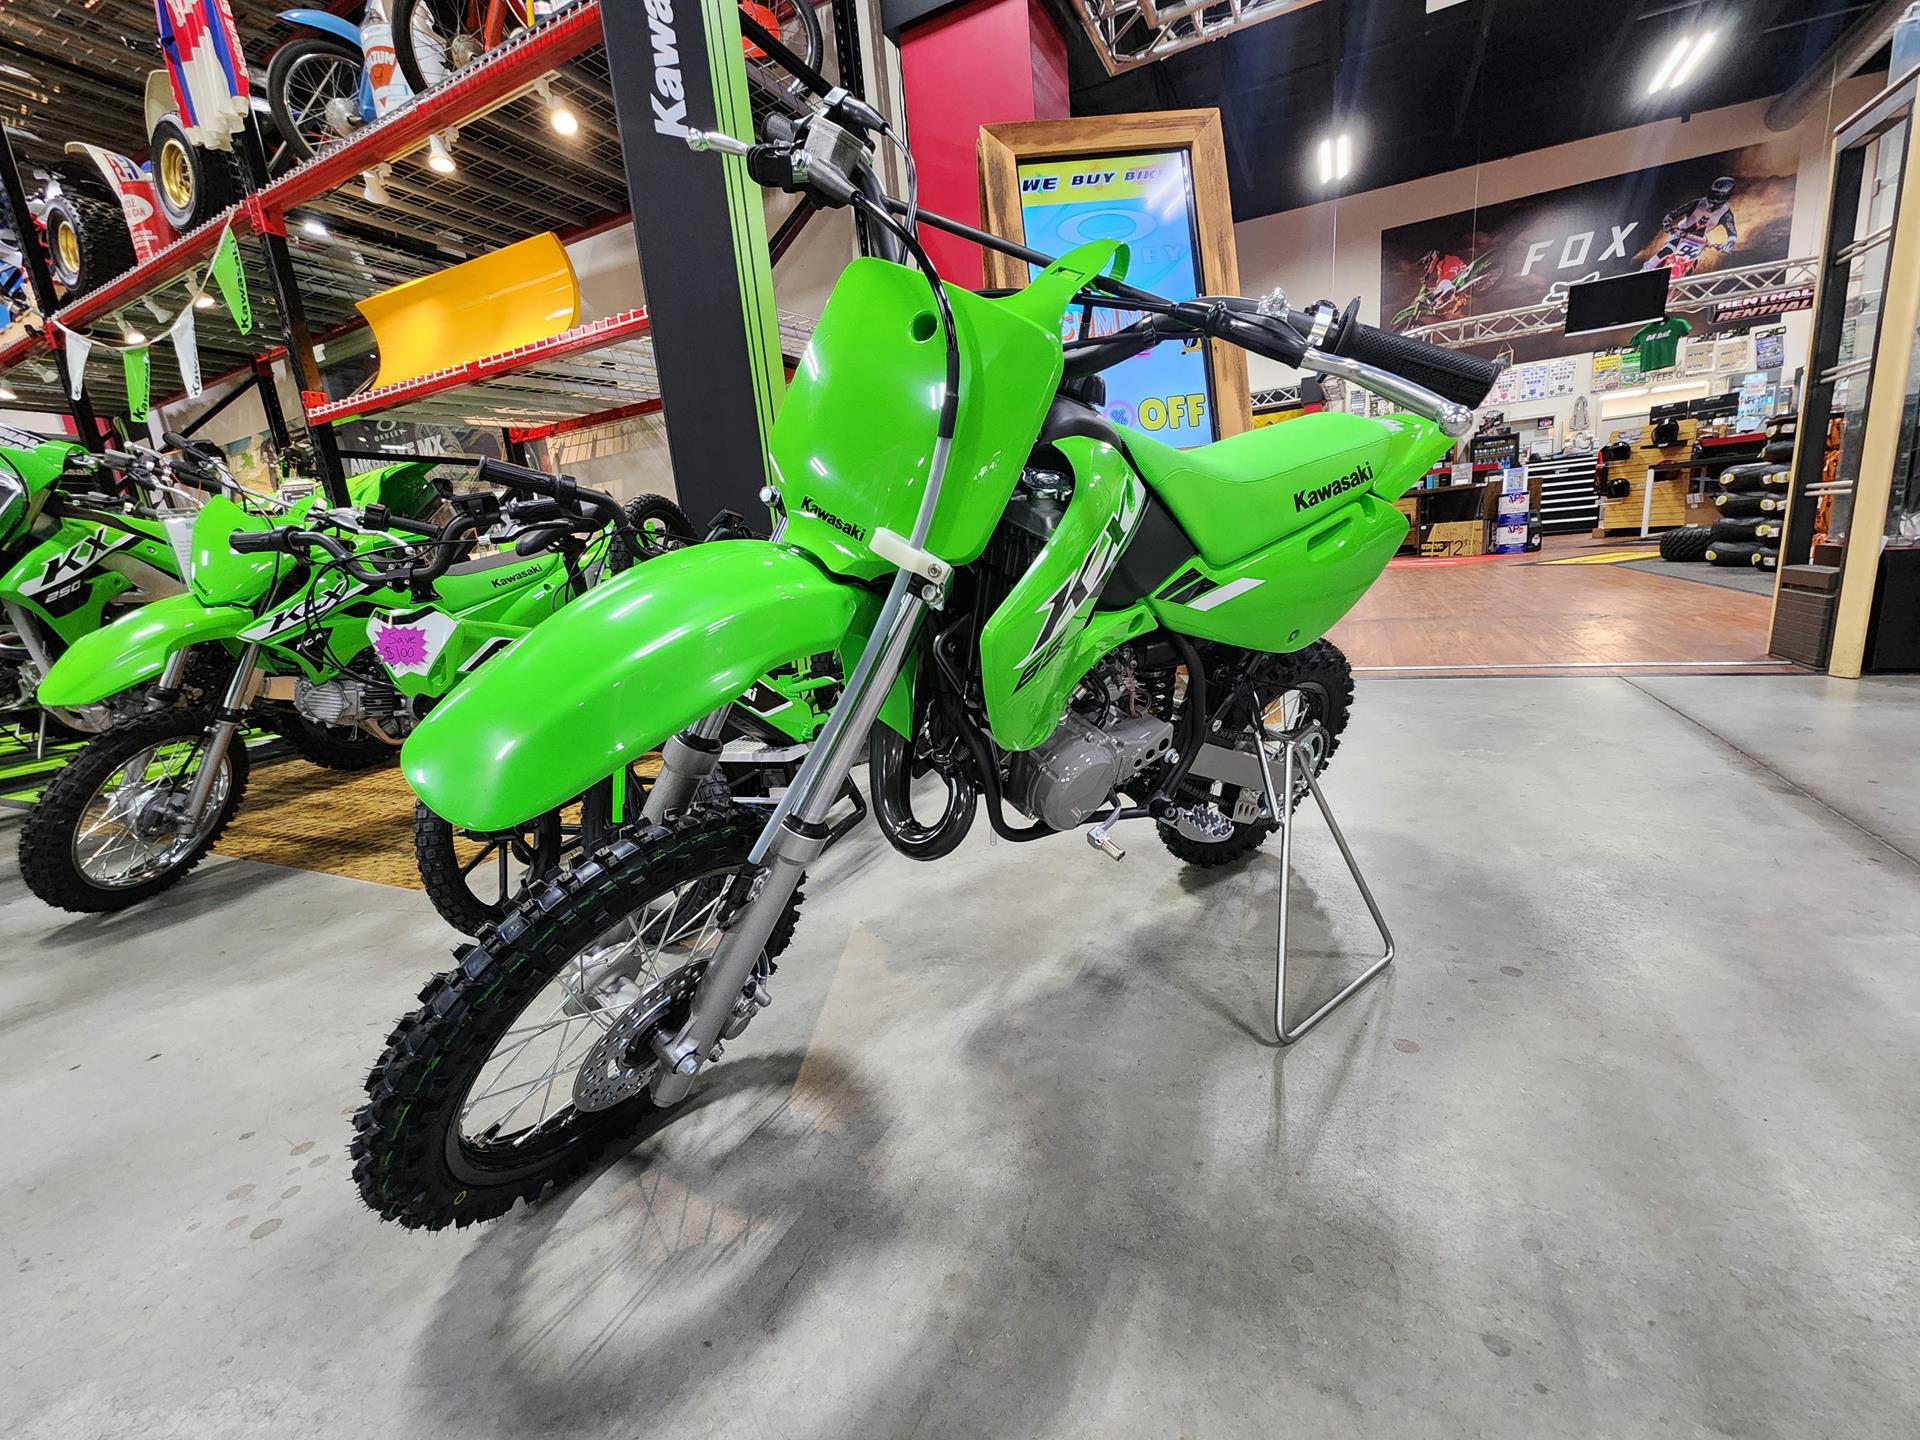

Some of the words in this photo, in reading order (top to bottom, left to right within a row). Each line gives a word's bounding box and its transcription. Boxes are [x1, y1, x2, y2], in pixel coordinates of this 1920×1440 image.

[1022, 178, 1058, 192] WE
[1071, 172, 1115, 186] BUY
[1520, 221, 1639, 277] FOX
[231, 239, 249, 329] Kawasaki
[1716, 299, 1811, 322] RENTHAL
[1717, 288, 1814, 310] RENTHAL
[1138, 393, 1205, 431] OFF
[416, 434, 445, 457] MX
[1293, 461, 1374, 513] Kawasaki
[801, 495, 867, 542] Kawasaki
[40, 527, 110, 588] KX
[491, 563, 543, 588] Kawasaki
[44, 579, 81, 604] 250
[388, 632, 416, 645] Save
[385, 646, 415, 661] $100
